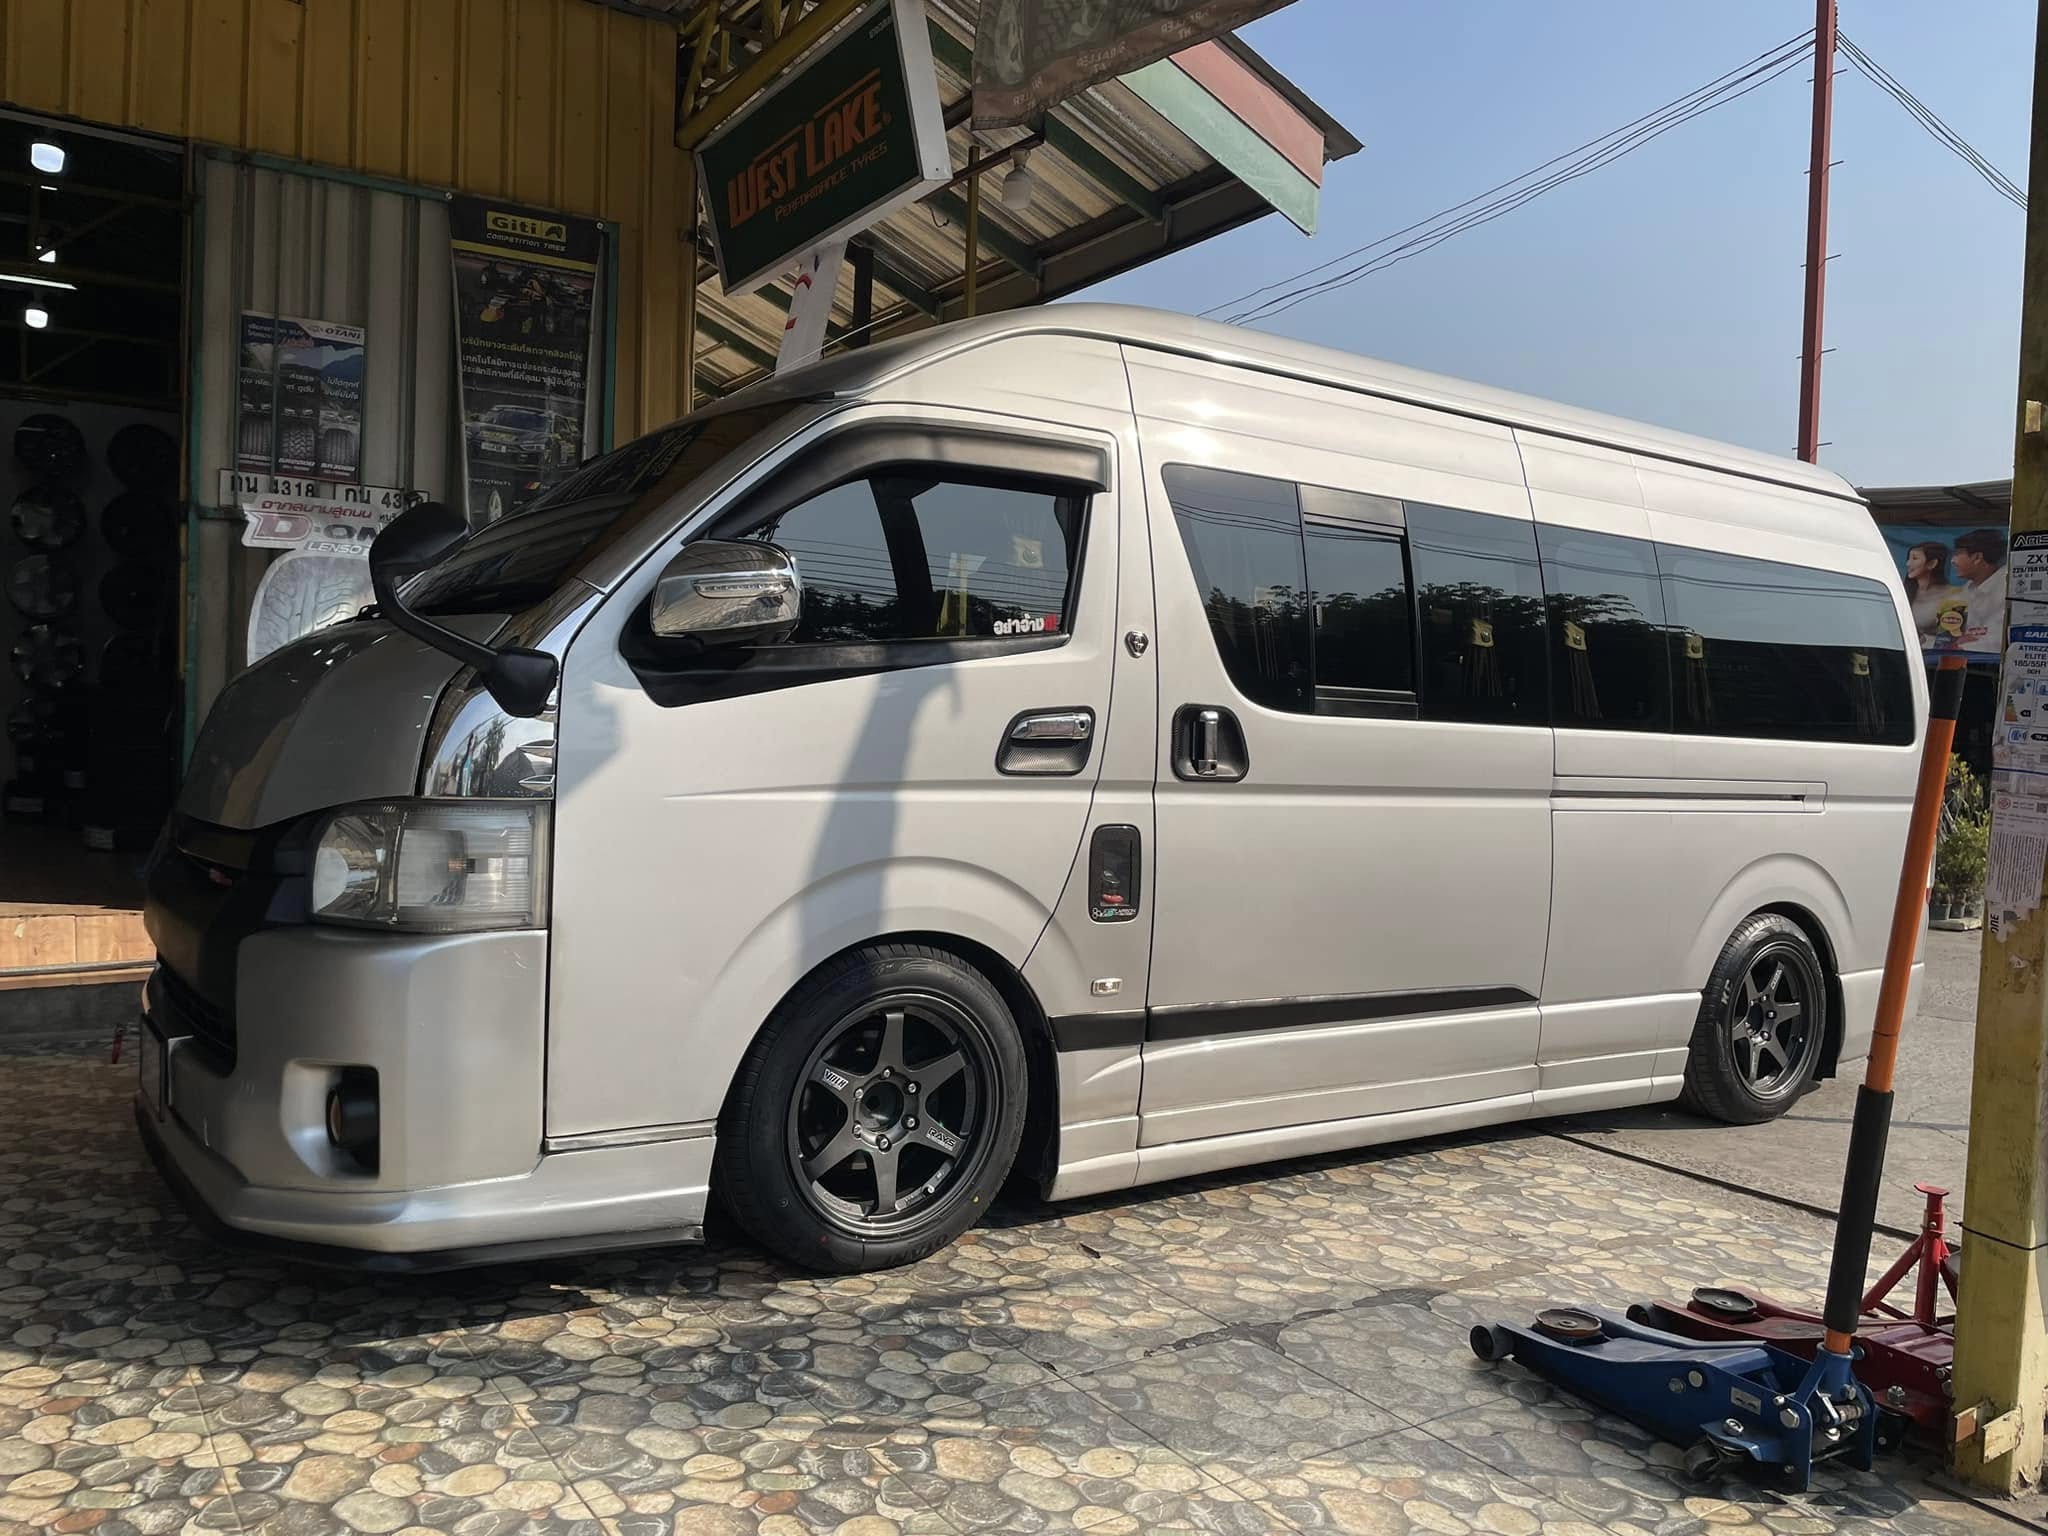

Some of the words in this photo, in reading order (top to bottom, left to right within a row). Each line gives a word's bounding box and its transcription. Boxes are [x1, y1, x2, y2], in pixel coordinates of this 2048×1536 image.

[727, 140, 800, 229] WEST
[804, 80, 883, 177] LAKE
[850, 140, 889, 177] TYRES
[491, 216, 538, 235] Giti
[325, 327, 361, 340] OTANI
[307, 541, 363, 555] LENSO
[2014, 660, 2048, 668] 185/55R
[928, 1127, 956, 1147] RAYS
